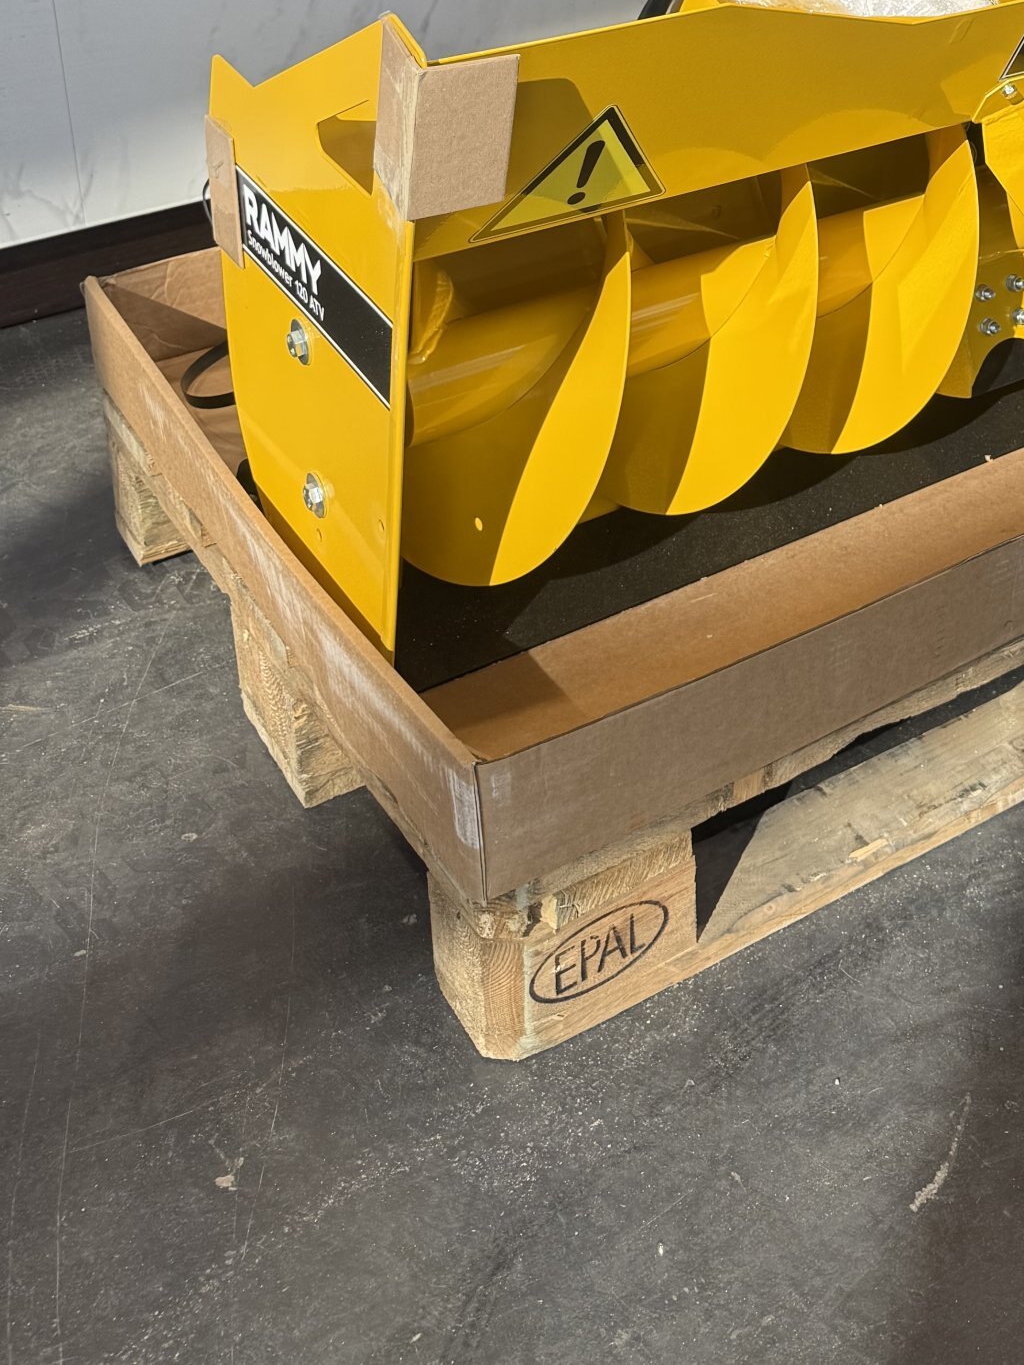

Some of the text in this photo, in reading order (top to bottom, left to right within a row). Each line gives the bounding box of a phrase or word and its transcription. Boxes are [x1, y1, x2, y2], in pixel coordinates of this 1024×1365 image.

[243, 183, 321, 295] RAMMY
[247, 229, 325, 322] Snowblower 120 ATV
[554, 913, 646, 996] EPAL
